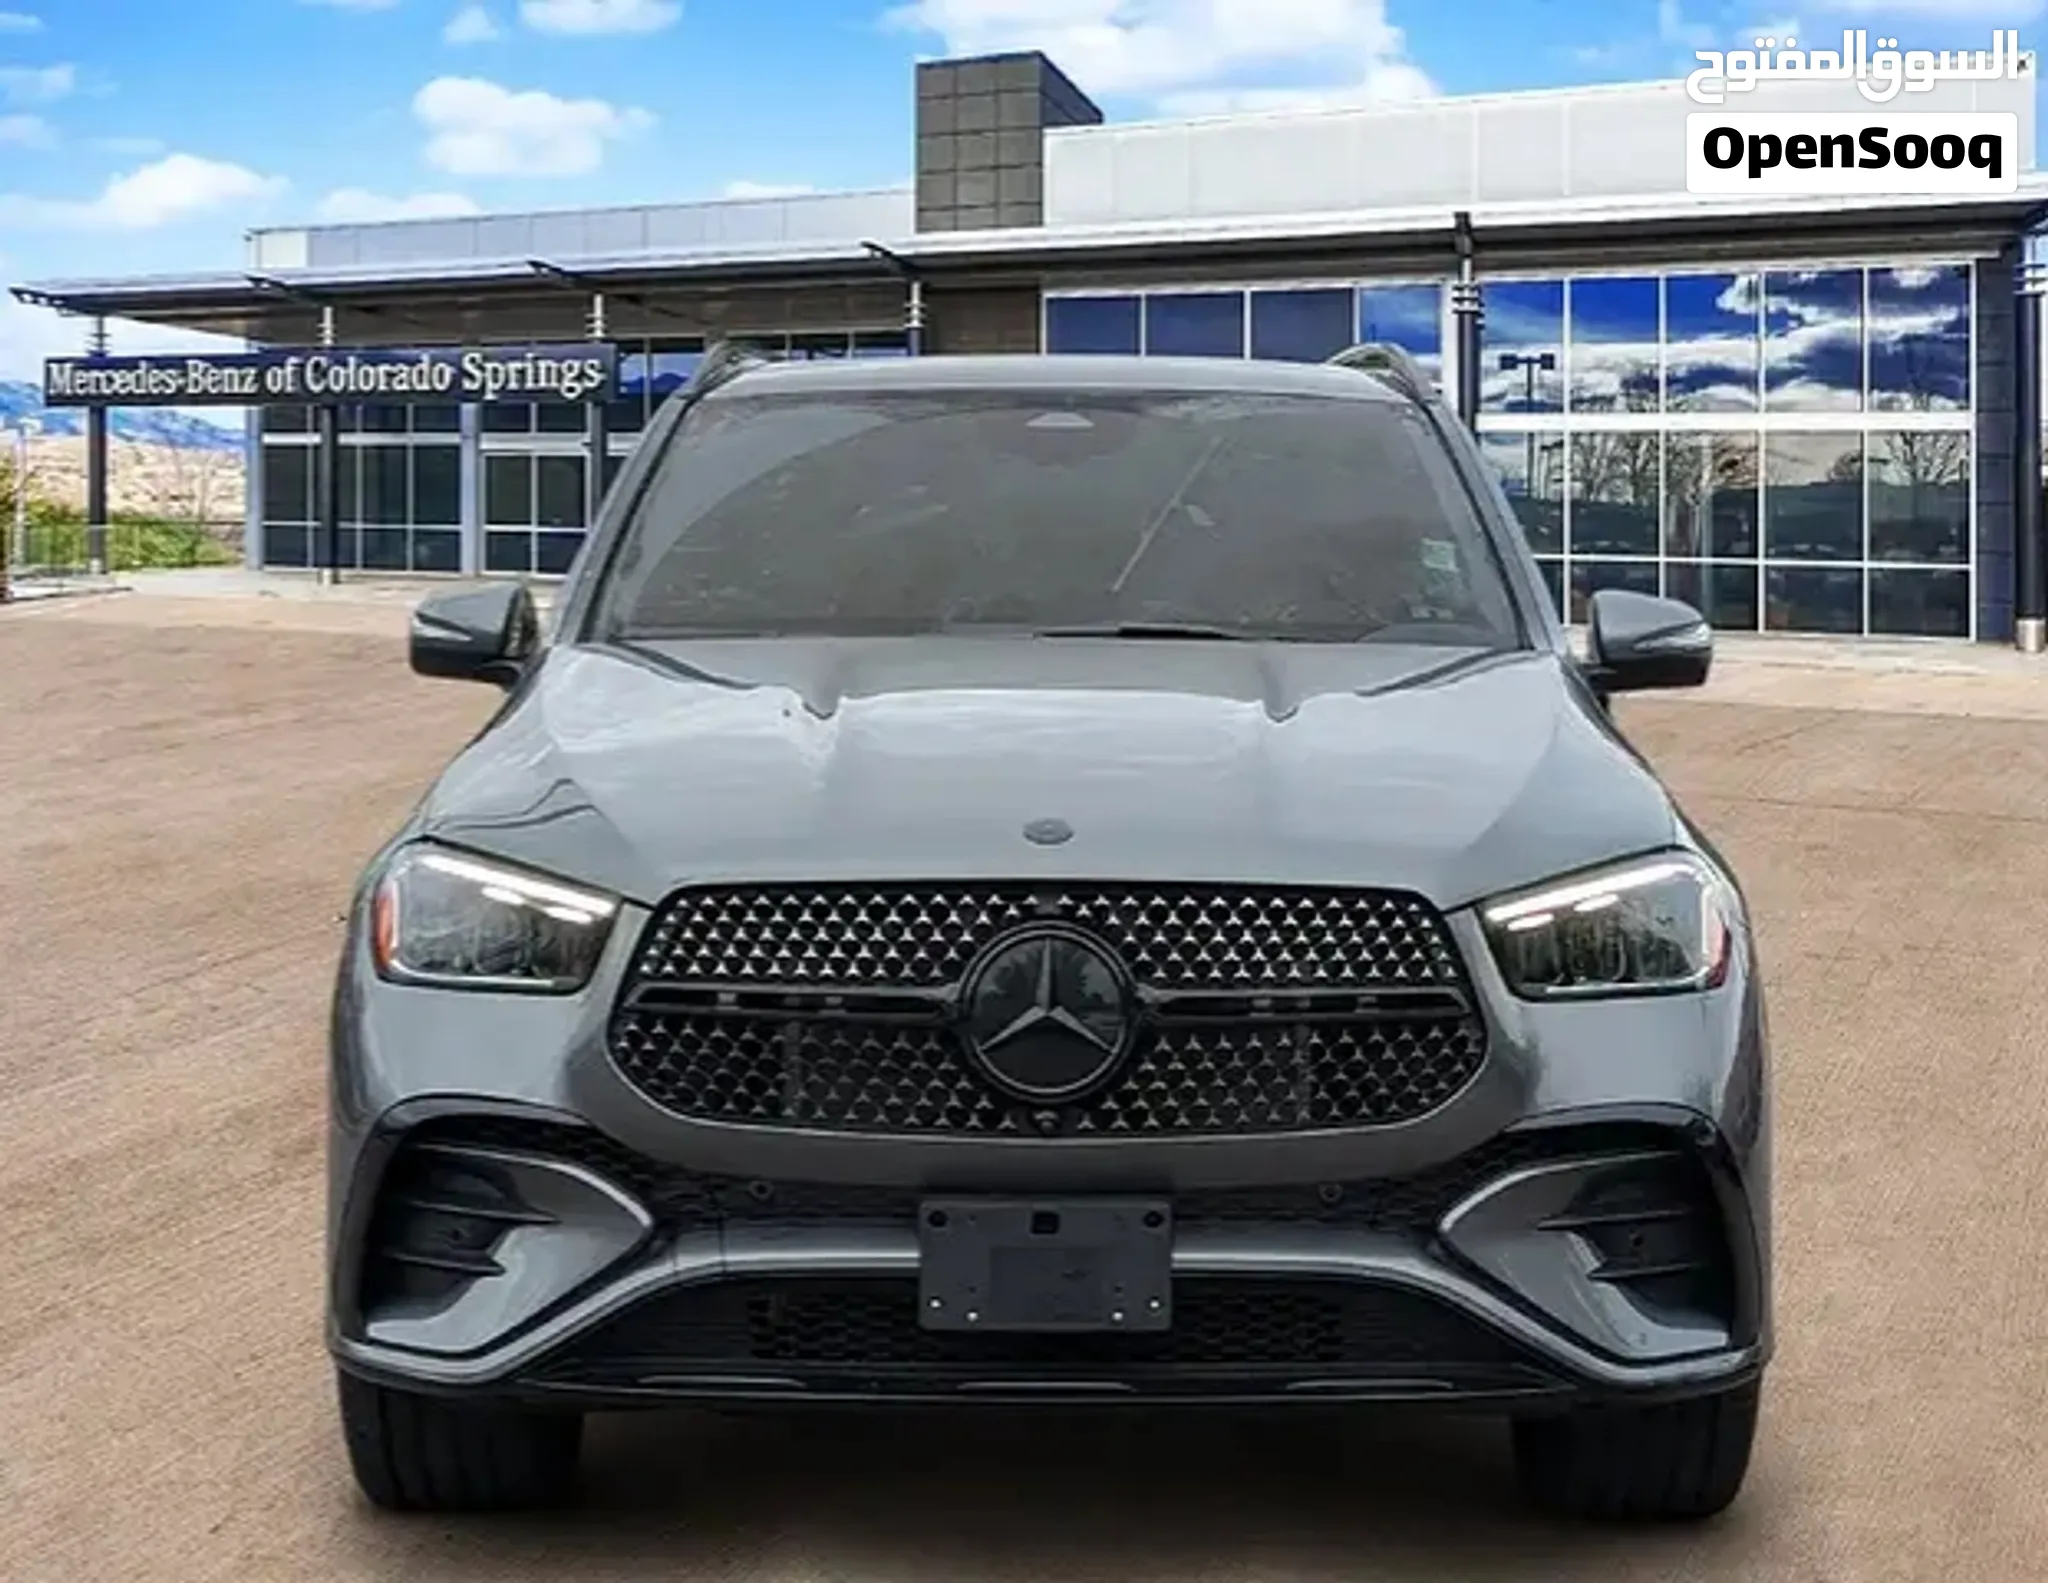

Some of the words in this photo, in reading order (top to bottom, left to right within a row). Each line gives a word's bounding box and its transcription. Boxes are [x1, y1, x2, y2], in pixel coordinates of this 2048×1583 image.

[47, 360, 259, 397] Mercedes-Benz
[265, 357, 301, 395] of
[305, 354, 453, 393] Colorado
[460, 352, 603, 399] Springs
